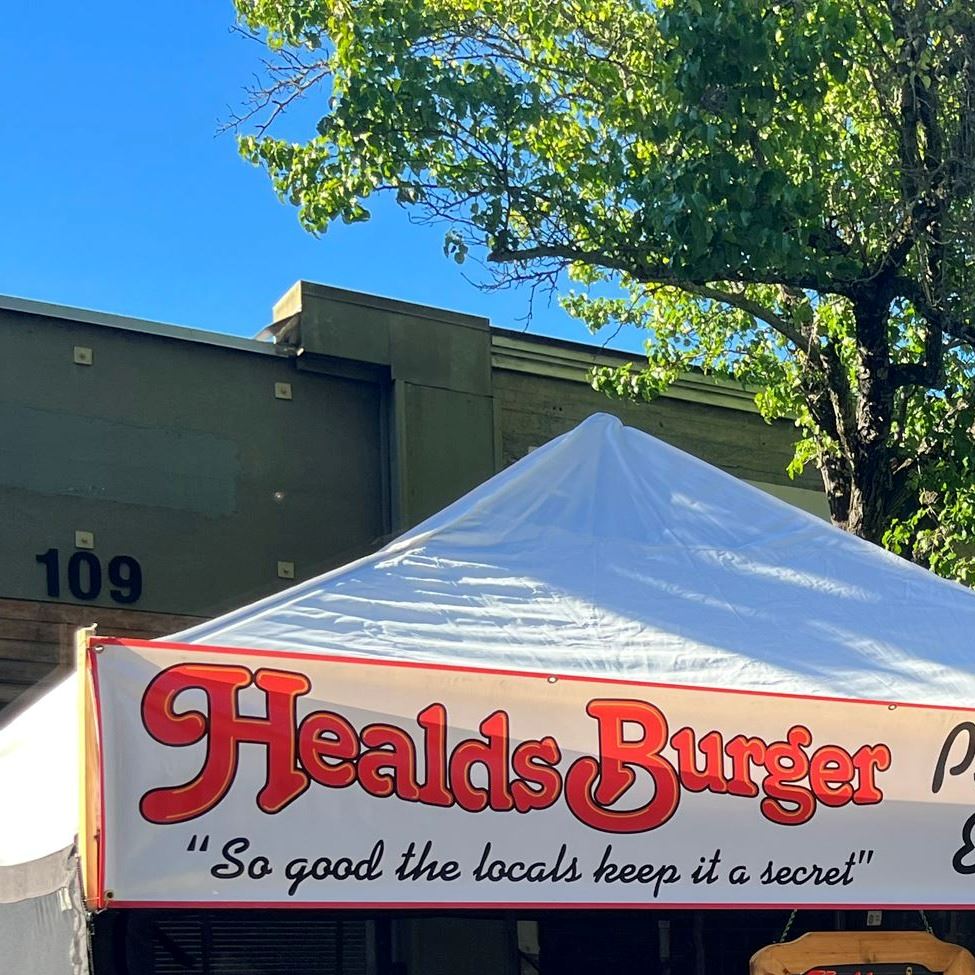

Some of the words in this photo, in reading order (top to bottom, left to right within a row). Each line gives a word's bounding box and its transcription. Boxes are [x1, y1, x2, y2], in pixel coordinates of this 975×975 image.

[36, 548, 142, 603] 109
[285, 839, 384, 896] good
[395, 840, 461, 881] the
[472, 842, 582, 883] locals
[593, 844, 680, 897] keep
[691, 848, 720, 885] it
[729, 865, 750, 884] a
